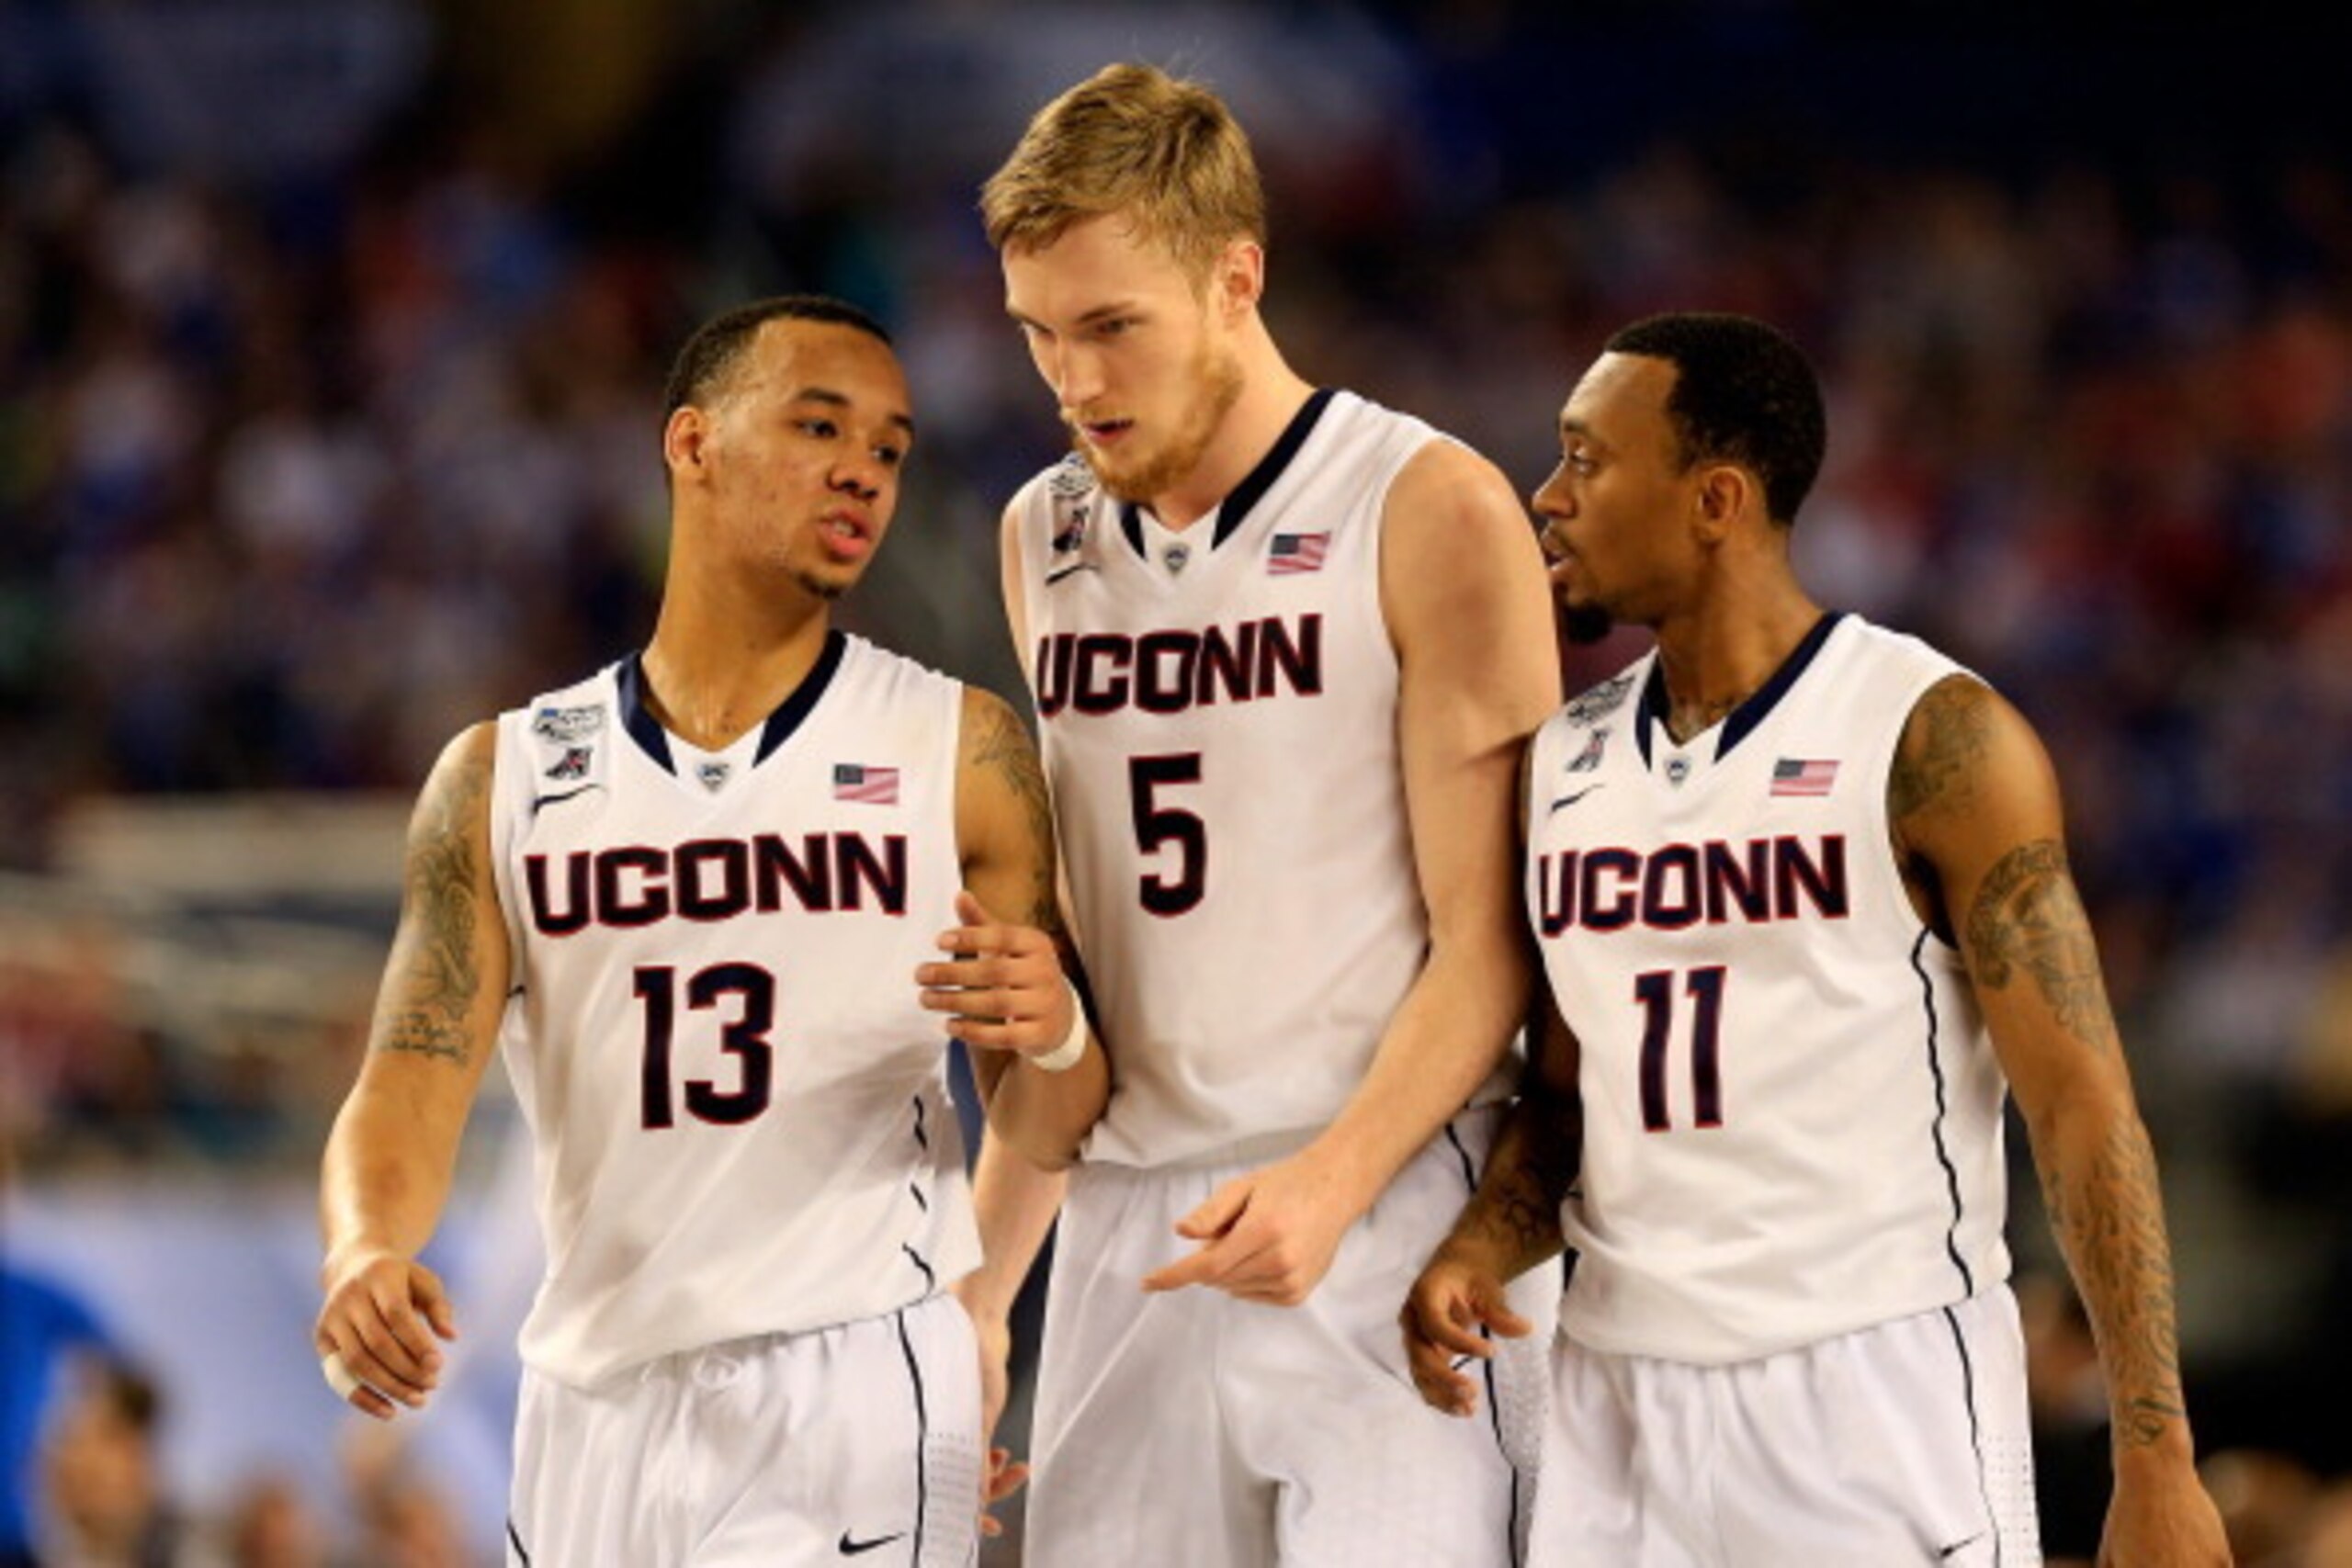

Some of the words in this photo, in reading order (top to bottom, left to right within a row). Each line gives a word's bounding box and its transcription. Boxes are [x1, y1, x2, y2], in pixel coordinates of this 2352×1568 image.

[1036, 613, 1323, 717] UCONN
[524, 832, 908, 938] UCONN
[1127, 750, 1208, 919] 5
[1538, 834, 1849, 939] UCONN
[632, 961, 776, 1131] 13
[1634, 964, 1727, 1134] 11
